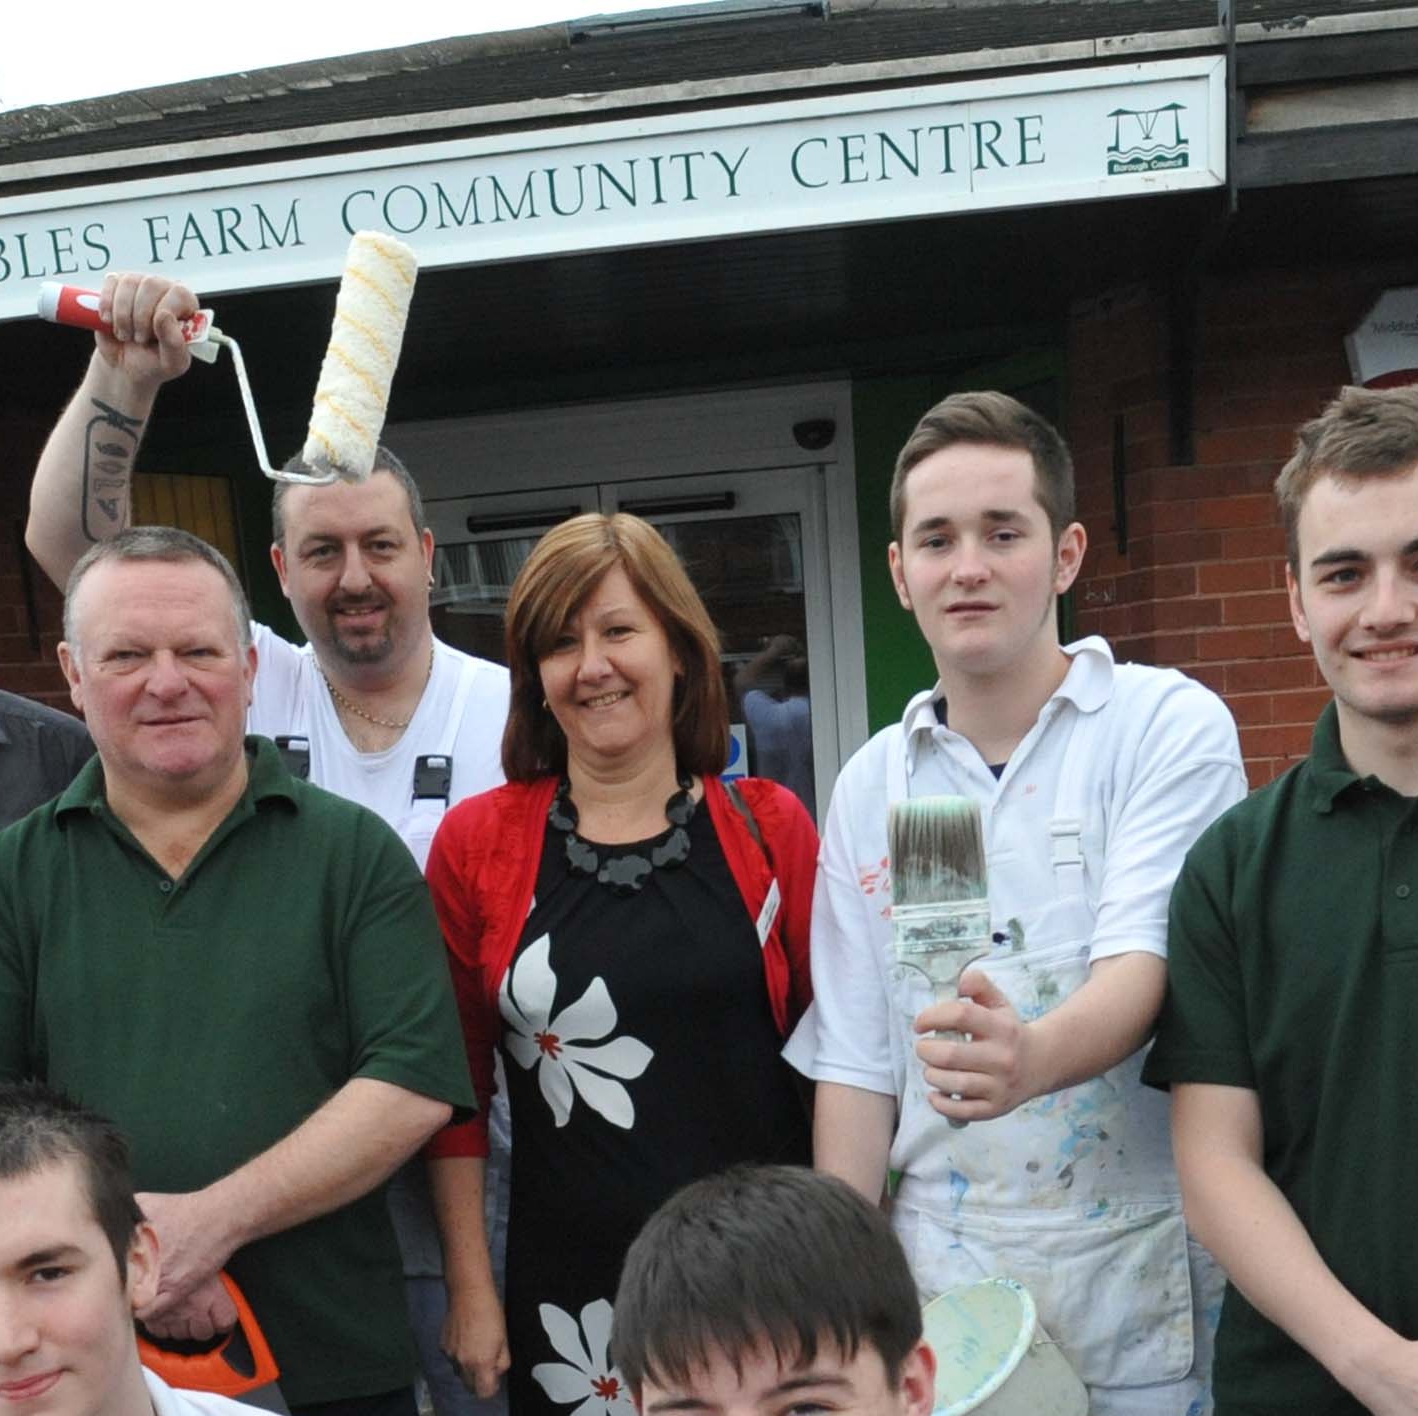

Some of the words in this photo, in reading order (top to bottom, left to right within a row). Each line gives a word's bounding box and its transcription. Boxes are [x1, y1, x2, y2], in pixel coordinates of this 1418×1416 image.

[144, 199, 304, 264] FARM
[341, 147, 750, 236] COMMUNITY
[791, 114, 1046, 189] CENTRE
[1113, 162, 1148, 173] Borough
[1151, 158, 1183, 169] Council
